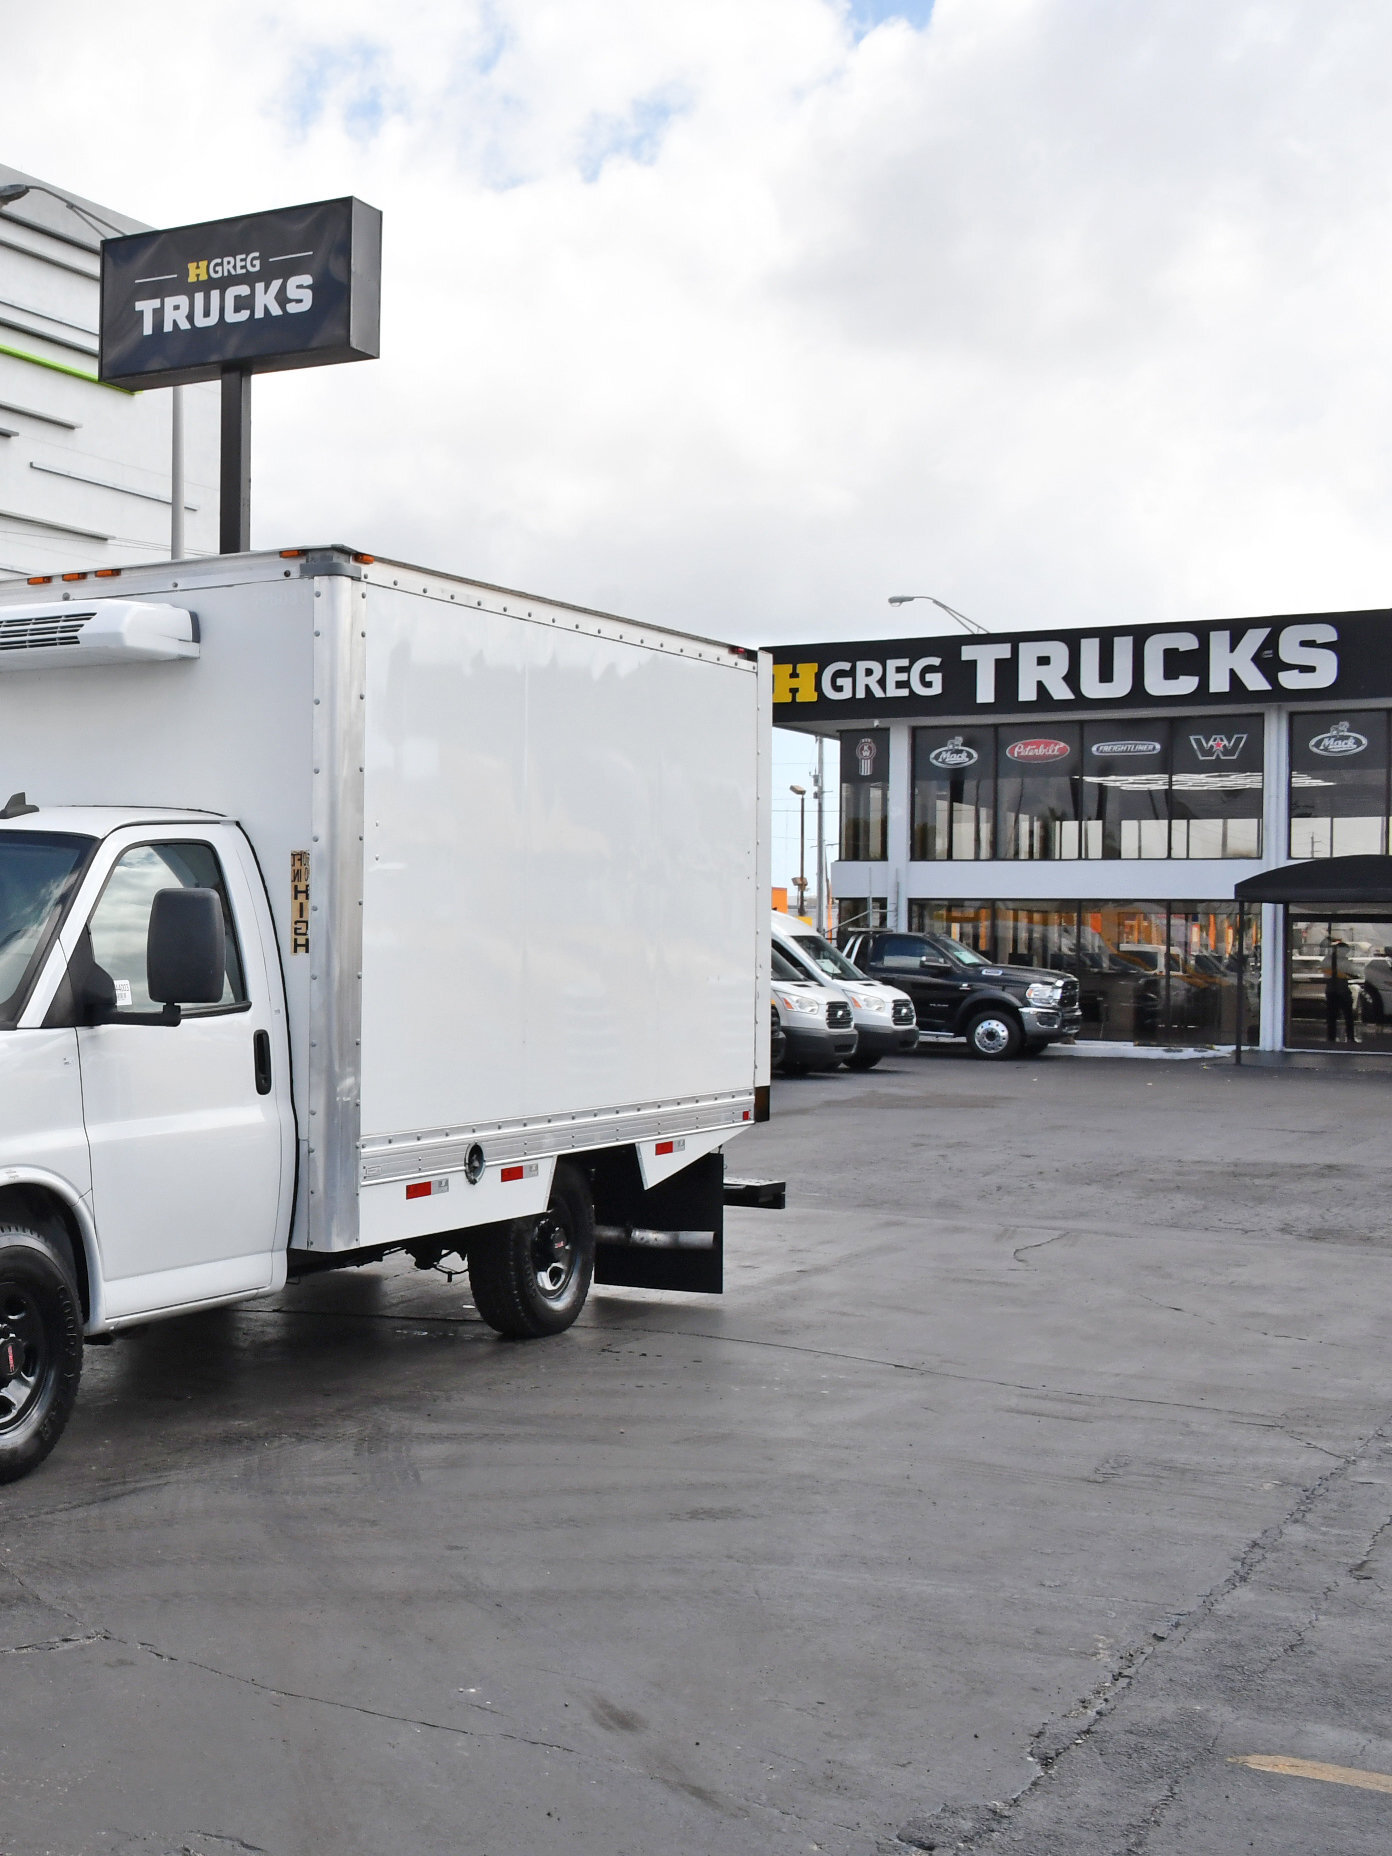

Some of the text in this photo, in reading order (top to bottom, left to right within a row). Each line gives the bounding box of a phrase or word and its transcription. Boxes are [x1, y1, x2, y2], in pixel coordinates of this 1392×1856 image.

[188, 251, 261, 283] HGREG
[134, 273, 314, 336] TRUCKS
[961, 623, 1339, 704] TRUCKS
[1014, 743, 1065, 758] Peterbilt
[1097, 744, 1154, 753] FREIGHTLINER
[1319, 737, 1358, 751] Mack
[938, 751, 969, 764] Mack
